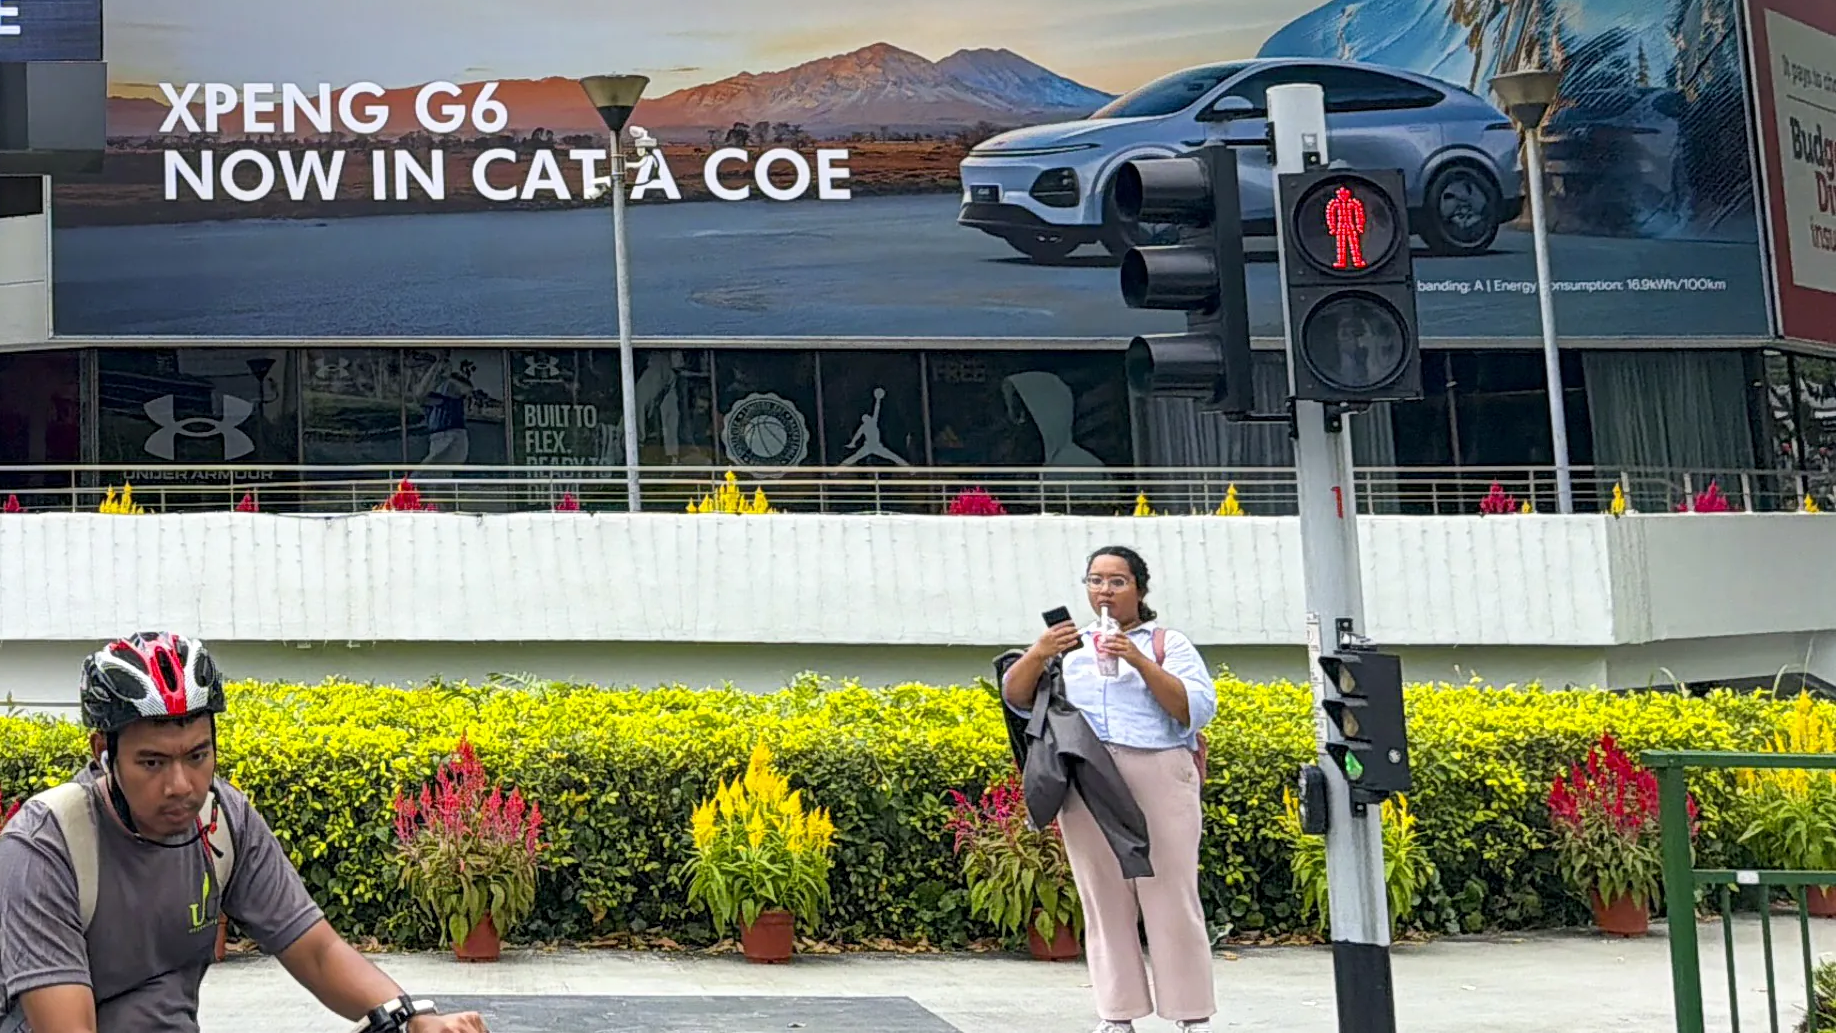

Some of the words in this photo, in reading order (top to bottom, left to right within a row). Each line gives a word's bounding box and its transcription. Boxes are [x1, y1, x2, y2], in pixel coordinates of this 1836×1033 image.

[158, 82, 390, 134] XPENG
[415, 81, 508, 134] G6
[164, 149, 346, 202] NOW
[373, 150, 437, 201] IN
[472, 149, 607, 201] CAT
[630, 148, 682, 200] A
[703, 148, 852, 201] COE
[1473, 281, 1484, 292] A
[1494, 280, 1537, 295] Energy
[524, 404, 571, 428] BUILT
[574, 405, 597, 428] TO
[525, 430, 572, 454] FLEX.
